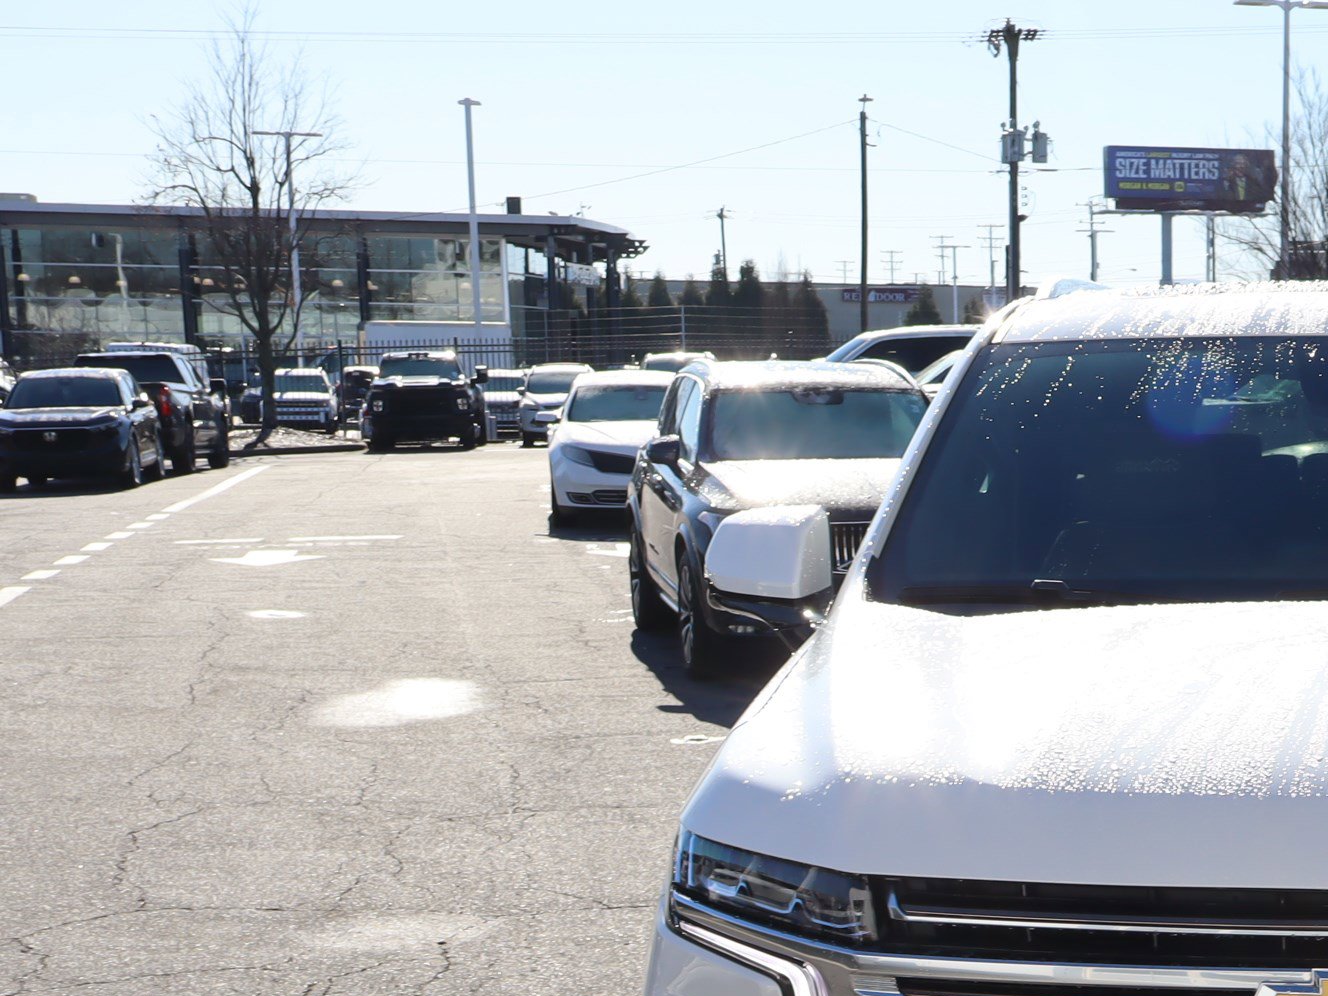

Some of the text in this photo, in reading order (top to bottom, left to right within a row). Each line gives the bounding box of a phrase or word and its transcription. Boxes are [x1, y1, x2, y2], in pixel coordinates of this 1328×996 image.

[1115, 158, 1219, 180] SIZE MATTERS
[876, 292, 906, 301] DOOR
